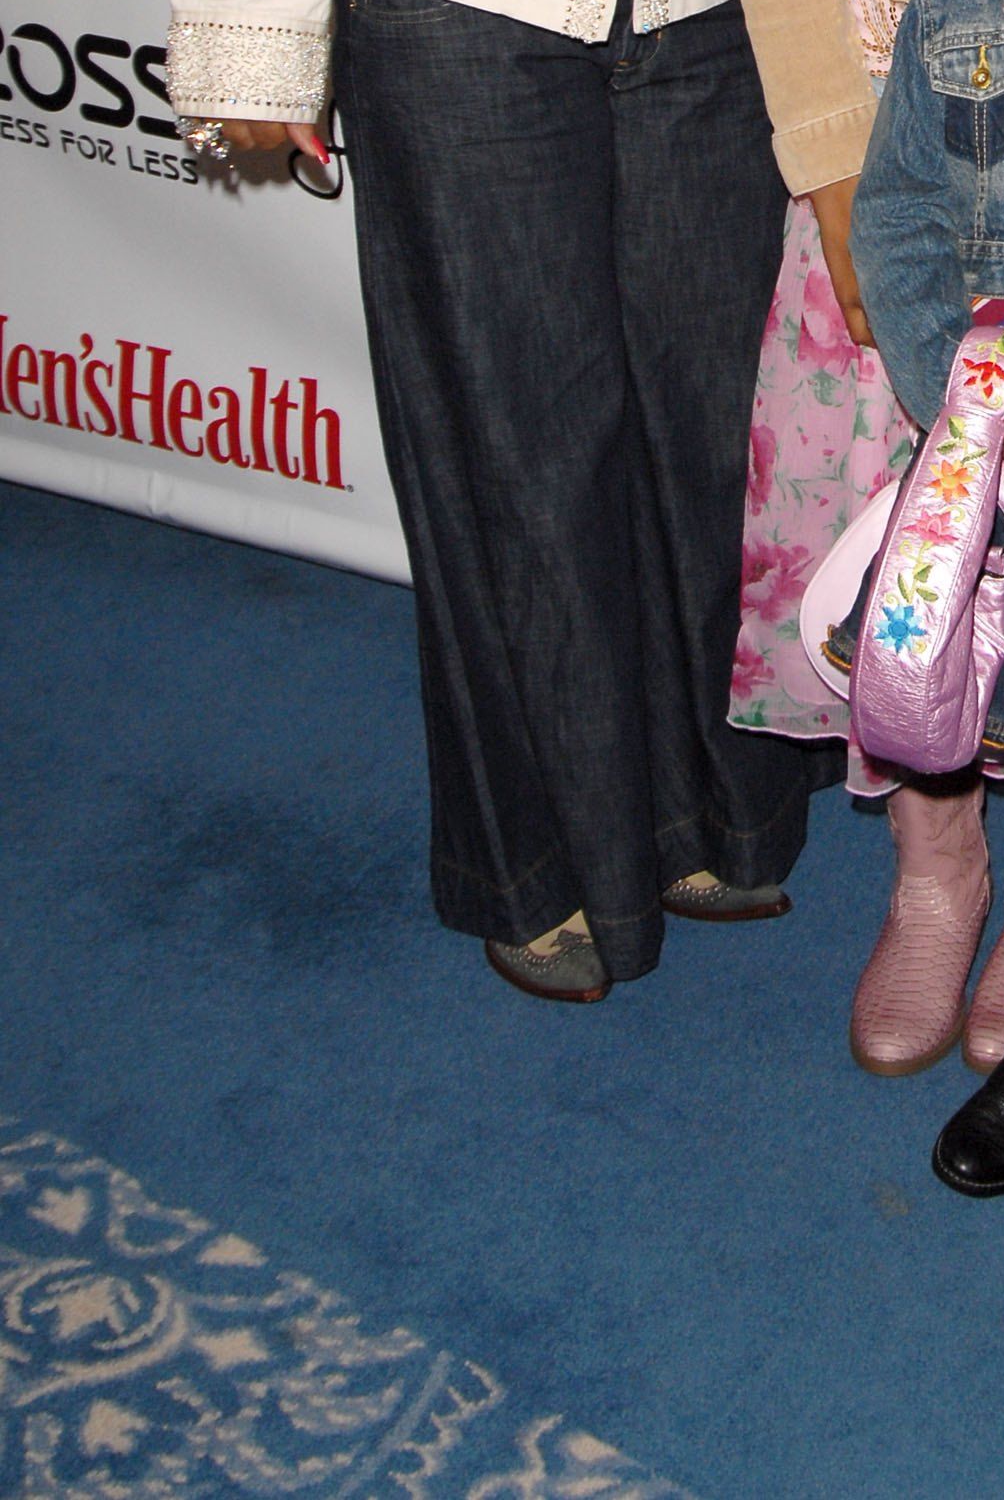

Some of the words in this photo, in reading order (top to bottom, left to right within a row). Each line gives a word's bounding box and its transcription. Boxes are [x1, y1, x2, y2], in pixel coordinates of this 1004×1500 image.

[0, 23, 184, 140] OSS
[60, 129, 117, 166] FOR
[127, 145, 199, 185] LESS
[0, 315, 346, 492] en'sHealth
